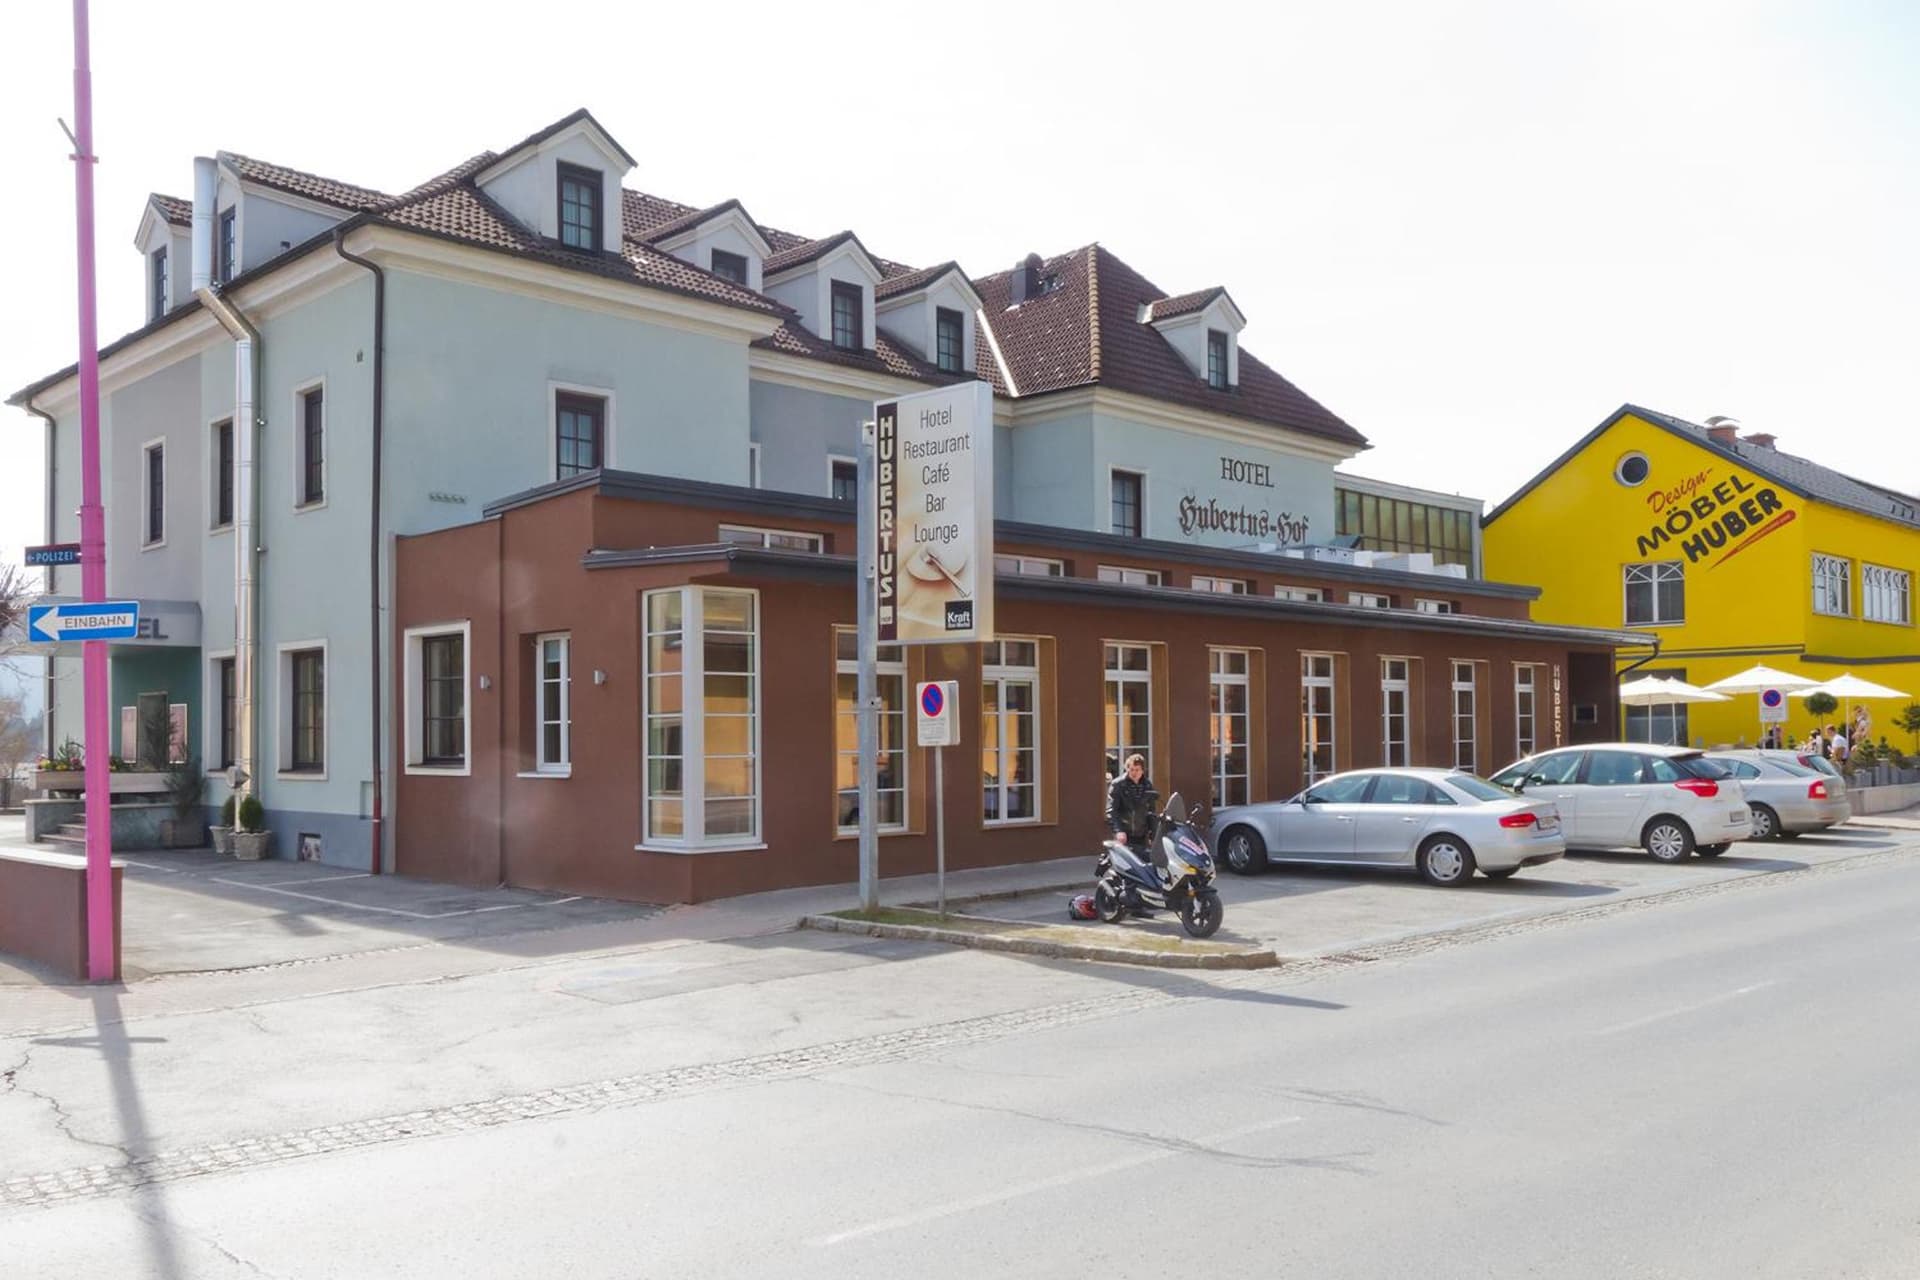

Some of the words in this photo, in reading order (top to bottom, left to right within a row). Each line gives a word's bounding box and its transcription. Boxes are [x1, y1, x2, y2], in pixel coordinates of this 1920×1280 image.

[920, 404, 952, 430] Hotel
[903, 432, 970, 459] Restaurant
[922, 462, 950, 485] Café
[1220, 457, 1275, 488] HOTEL
[879, 416, 893, 598] HUBERTUS
[926, 493, 946, 513] Bar
[1637, 475, 1754, 557] MÖBEL
[1681, 488, 1783, 563] HUBER
[914, 523, 959, 544] Lounge
[36, 551, 73, 561] POLIZEI
[64, 616, 127, 629] EINBAHN
[947, 611, 970, 624] Kraft
